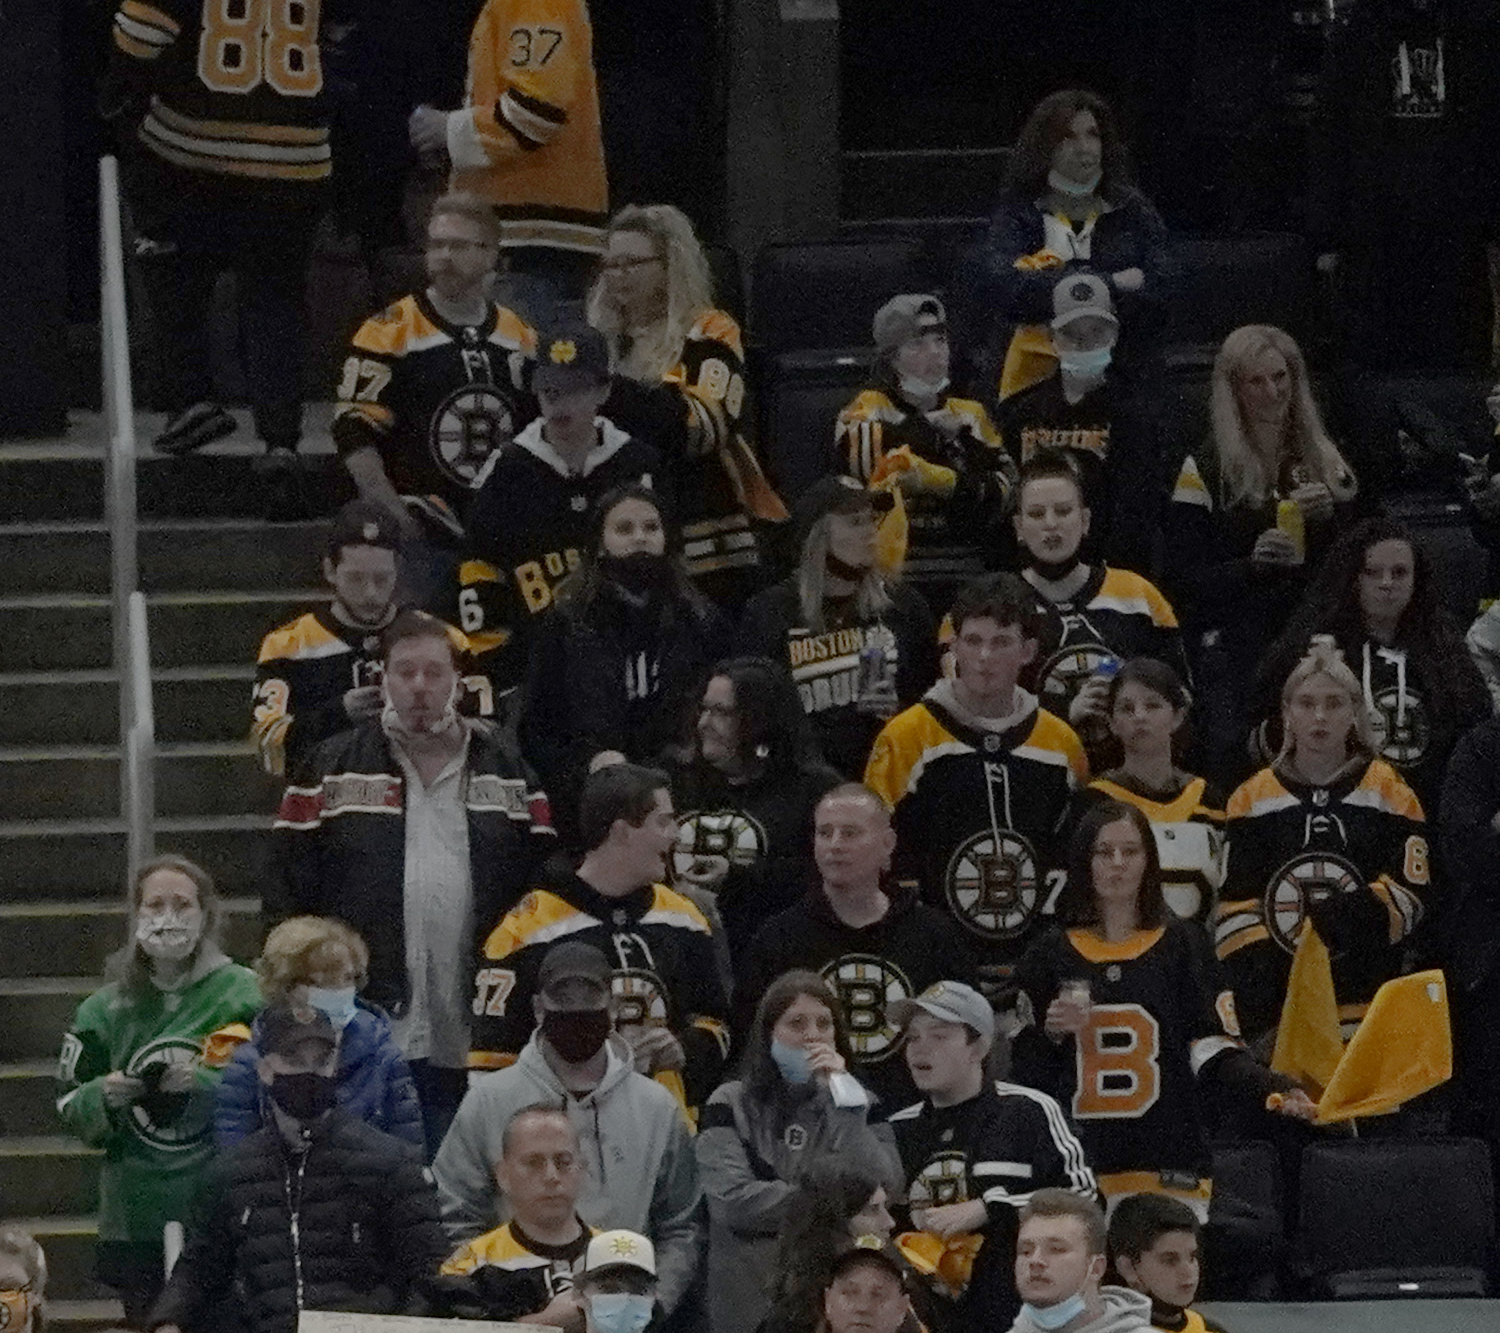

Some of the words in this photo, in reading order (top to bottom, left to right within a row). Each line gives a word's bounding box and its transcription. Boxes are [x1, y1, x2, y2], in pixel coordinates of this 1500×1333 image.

[197, 0, 325, 97] 88
[509, 28, 562, 69] 37
[460, 588, 483, 633] 6
[790, 629, 865, 662] BOSTON
[979, 860, 1017, 908] B
[847, 985, 886, 1032] B
[1075, 1005, 1161, 1118] B
